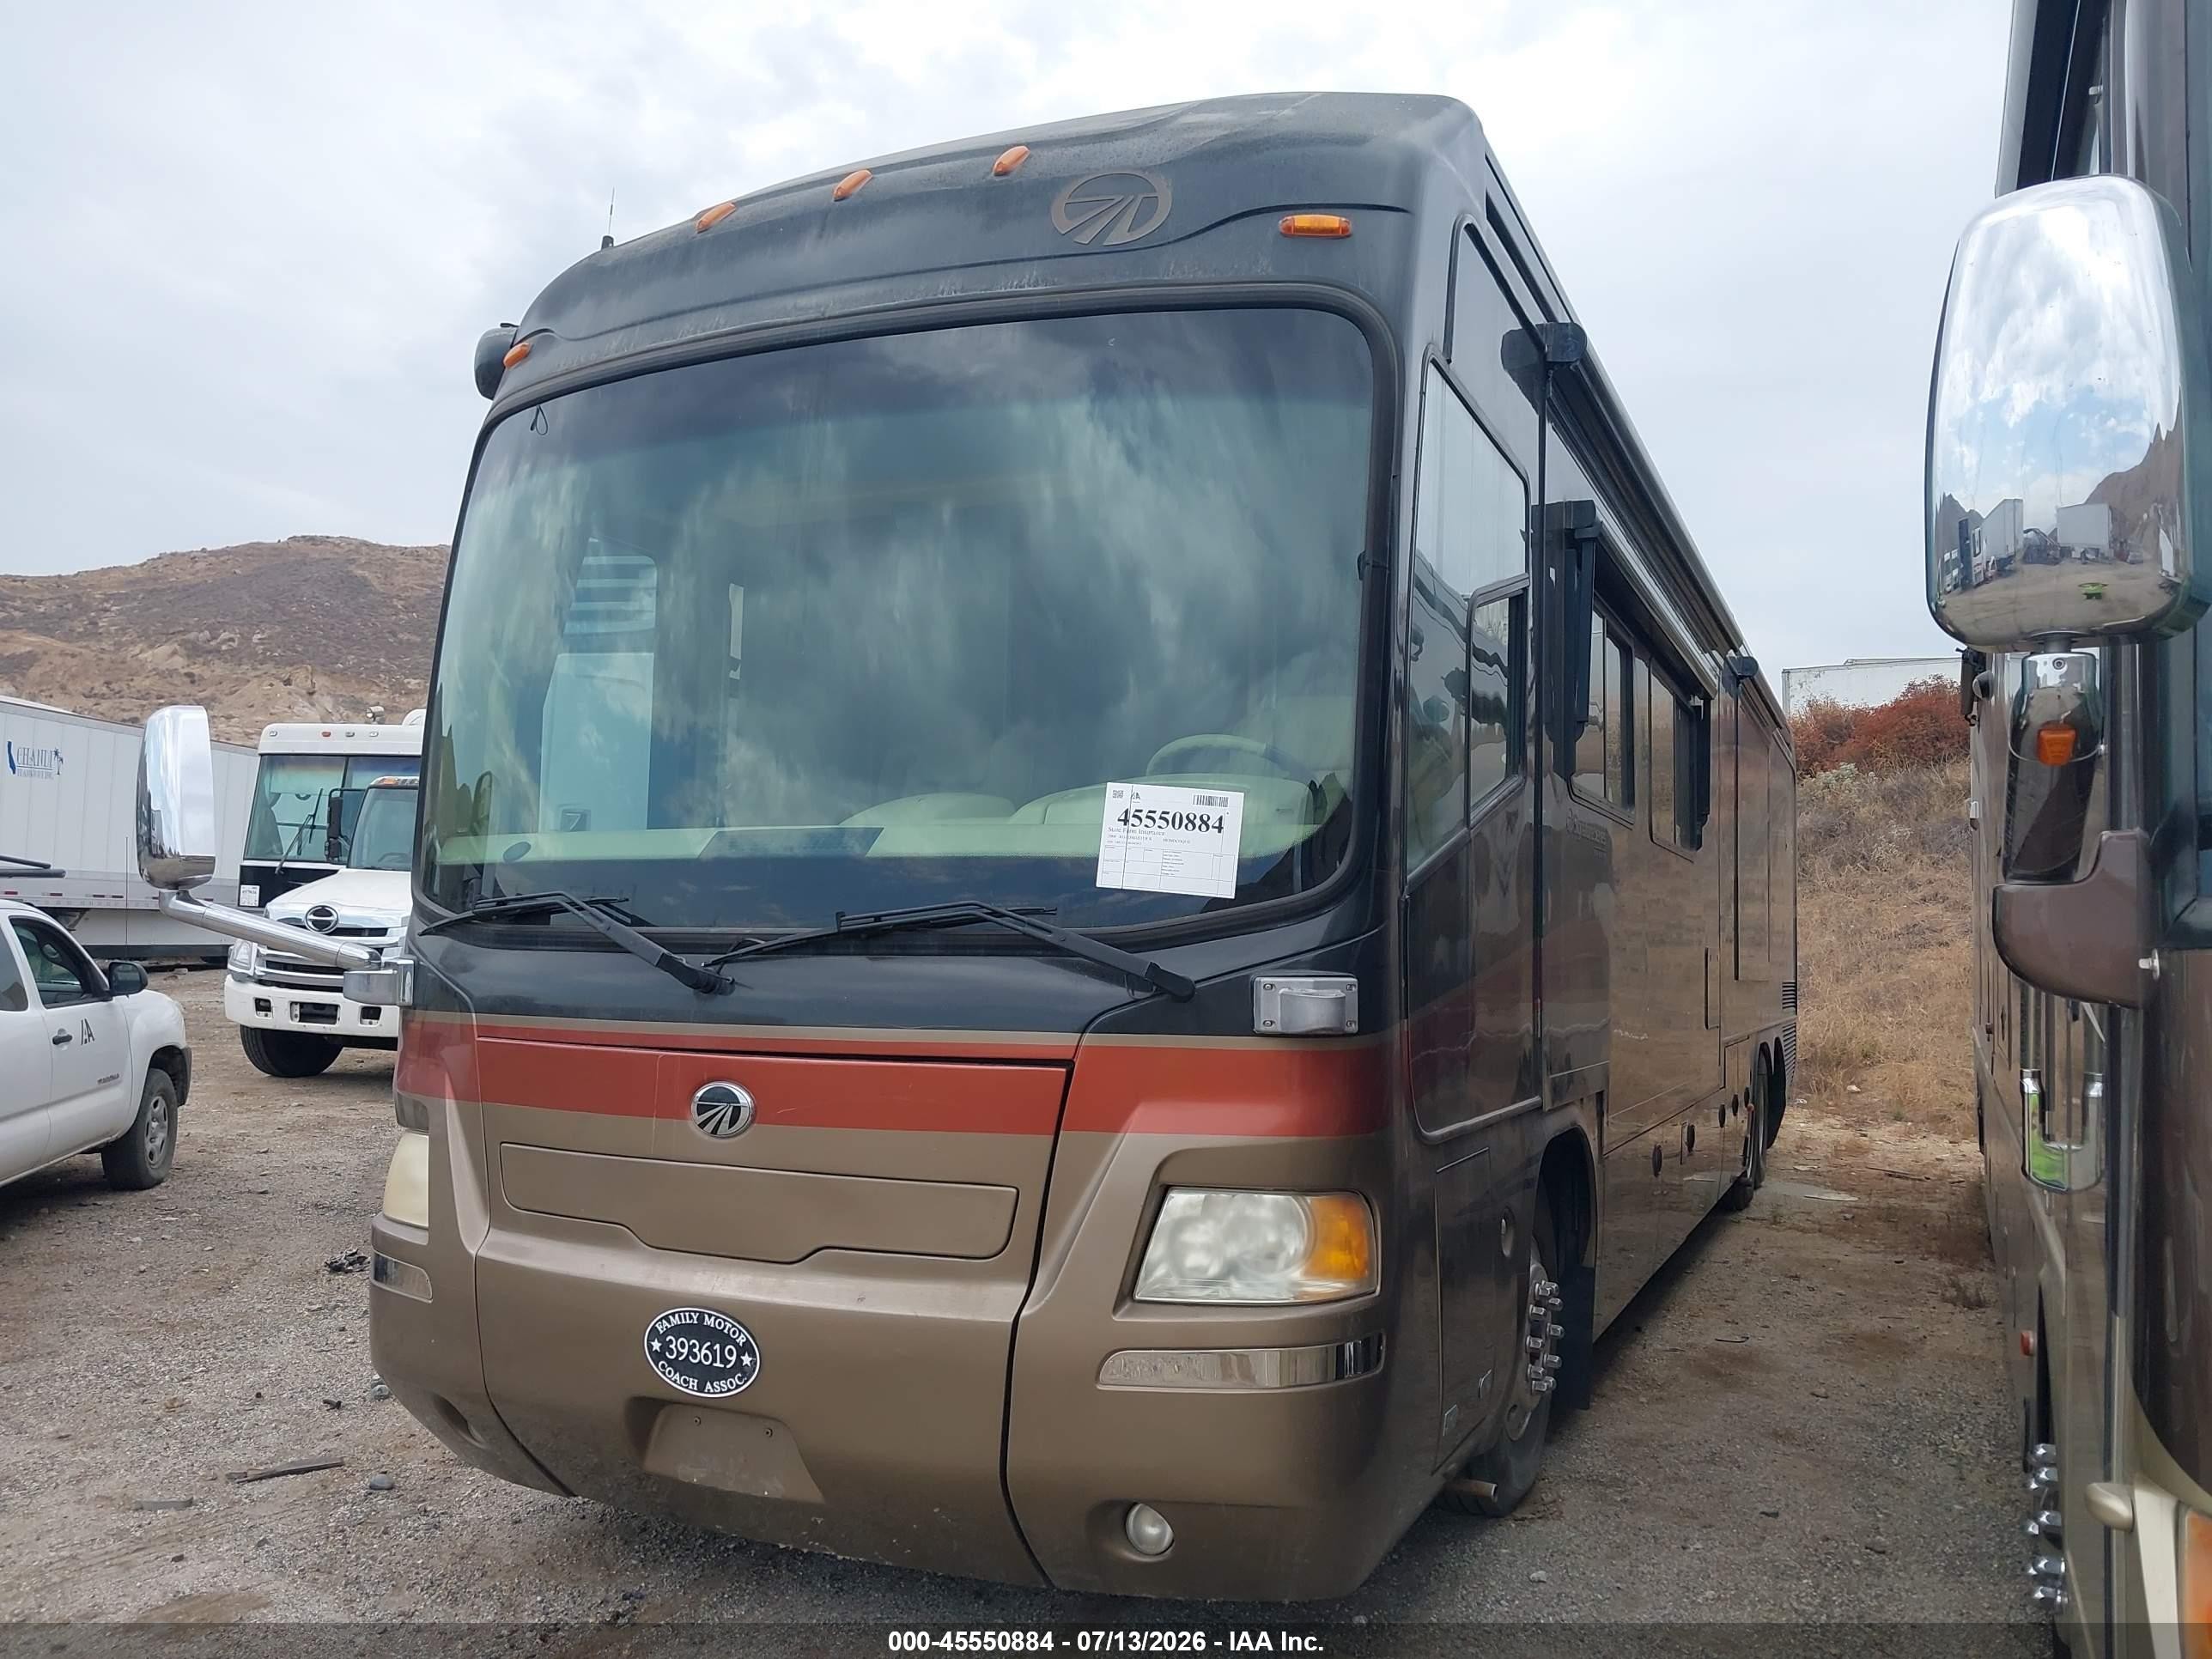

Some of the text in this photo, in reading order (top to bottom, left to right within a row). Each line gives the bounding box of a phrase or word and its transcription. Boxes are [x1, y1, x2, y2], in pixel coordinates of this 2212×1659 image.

[1117, 808, 1224, 833] 45550884
[656, 1312, 746, 1347] FAMILY MOTOR
[665, 1335, 738, 1369] 393619
[659, 1360, 748, 1393] COACH ASSOC.
